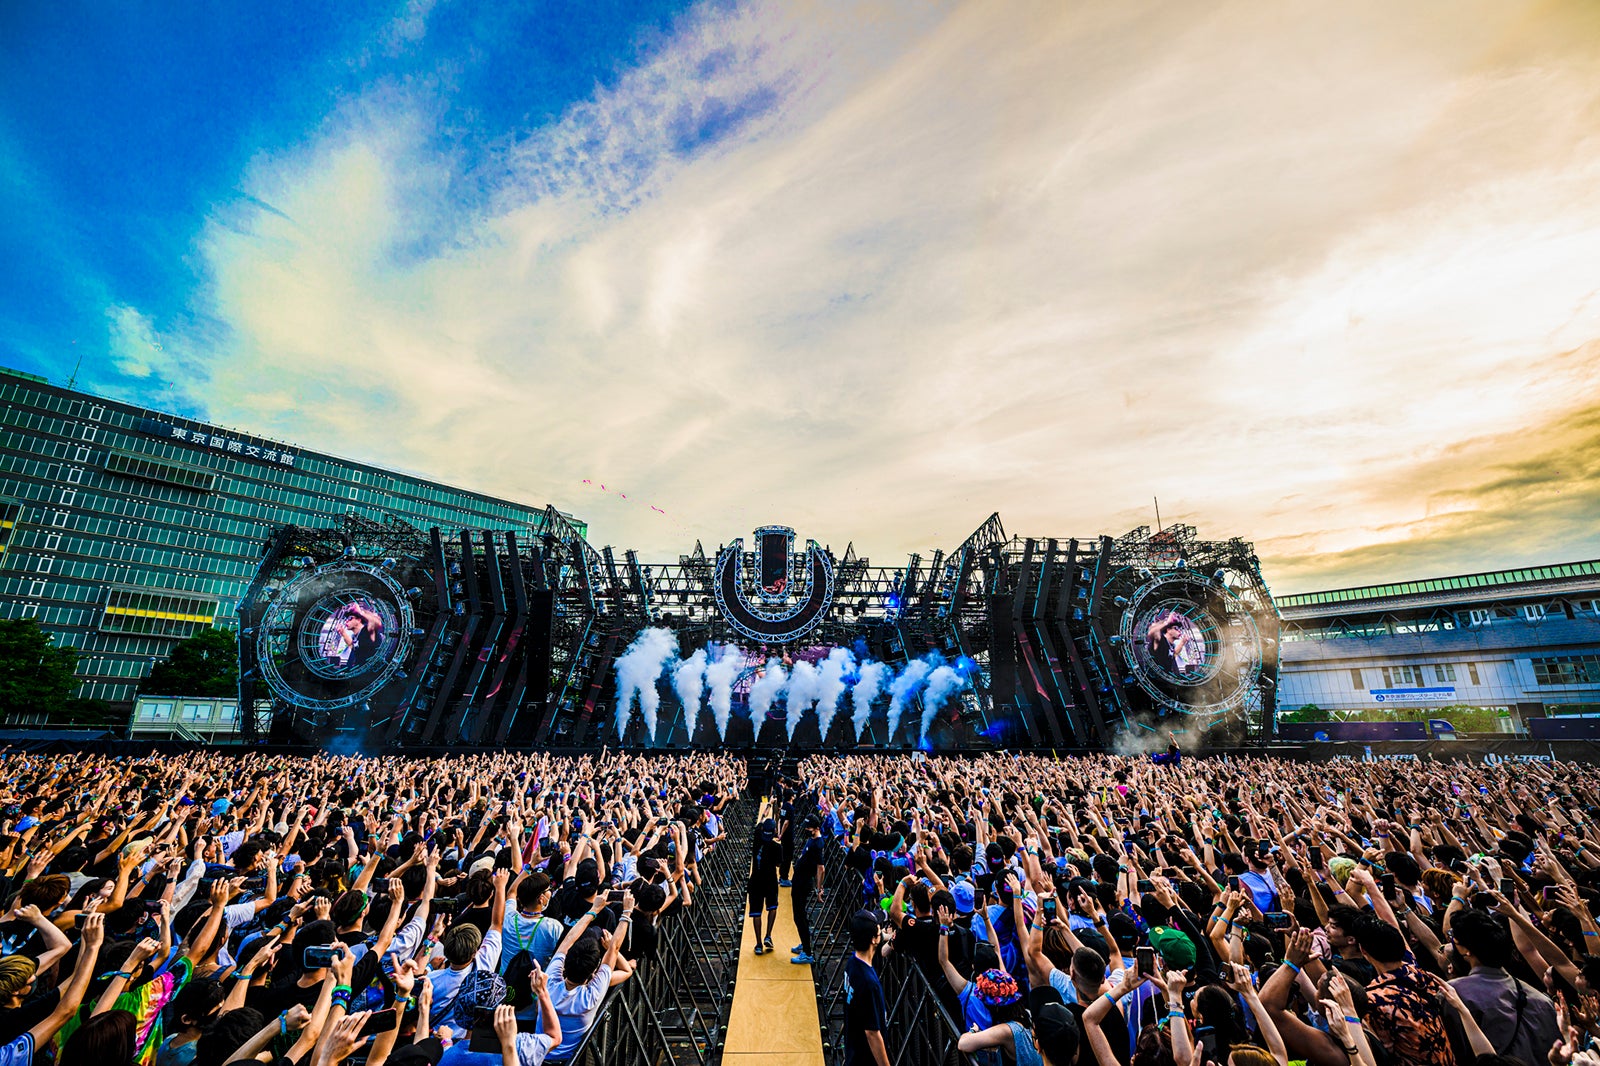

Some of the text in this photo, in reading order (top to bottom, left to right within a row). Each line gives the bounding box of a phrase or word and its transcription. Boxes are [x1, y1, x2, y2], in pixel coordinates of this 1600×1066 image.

[171, 427, 295, 466] 東京国際交流館
